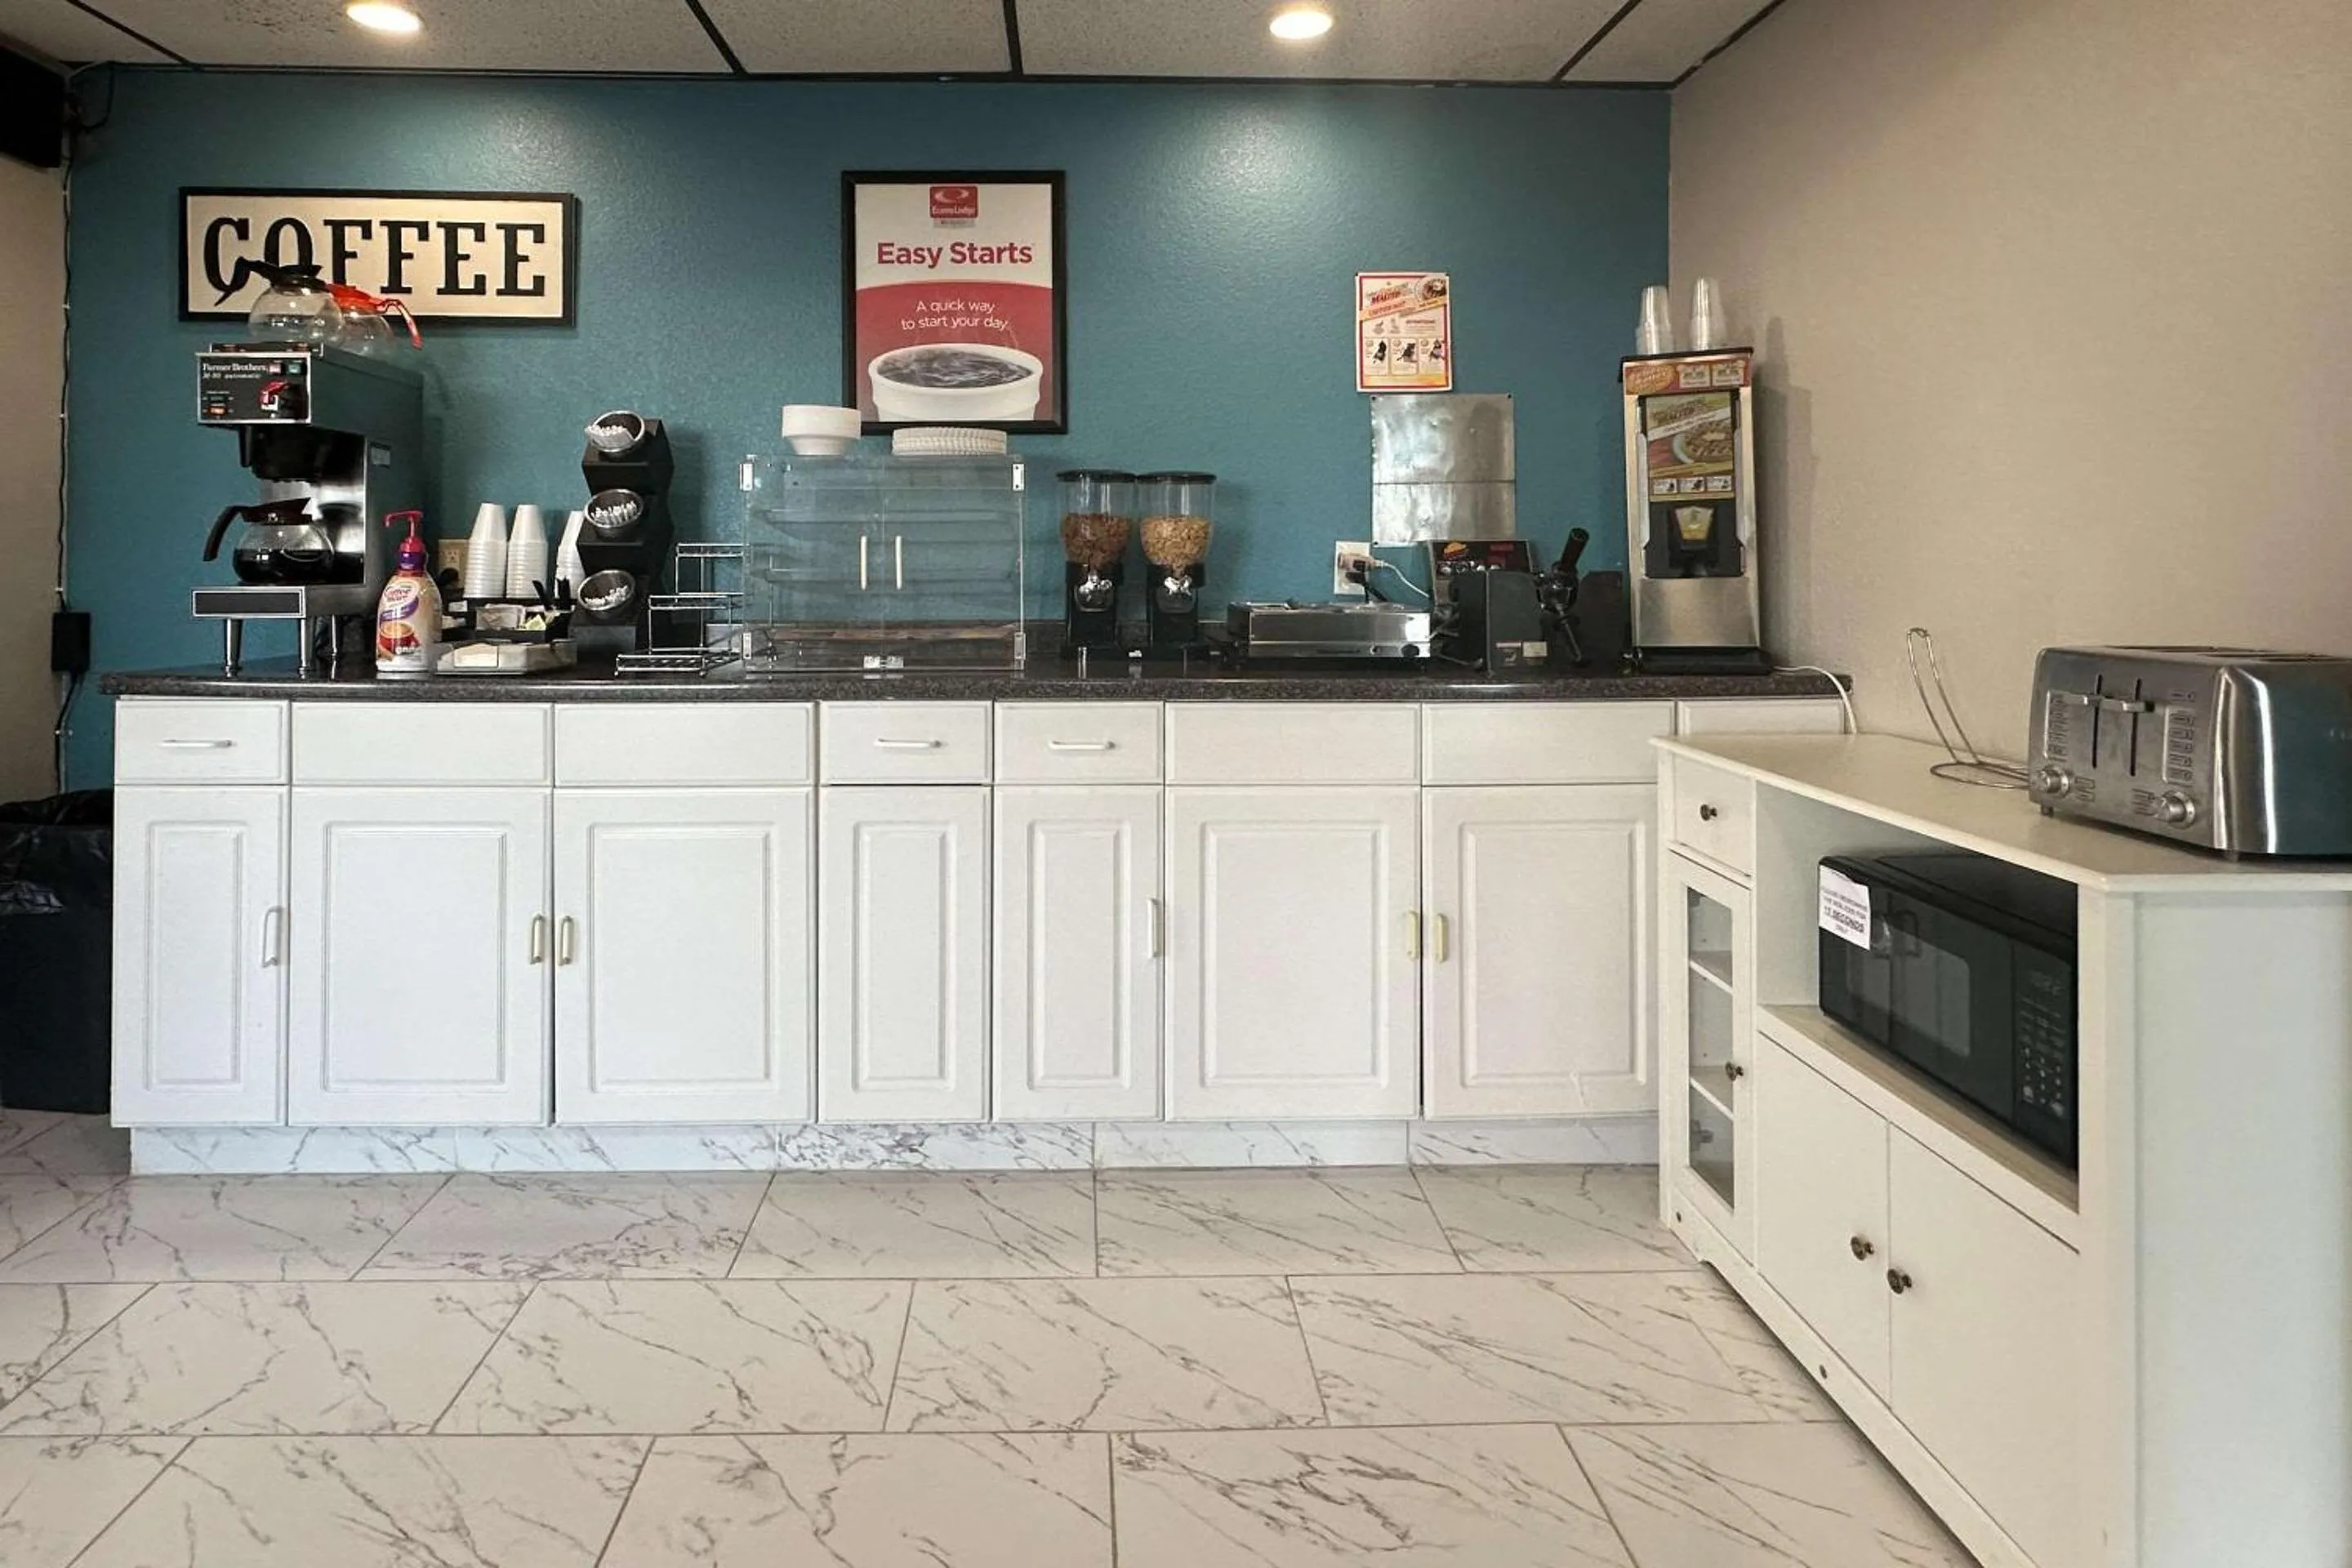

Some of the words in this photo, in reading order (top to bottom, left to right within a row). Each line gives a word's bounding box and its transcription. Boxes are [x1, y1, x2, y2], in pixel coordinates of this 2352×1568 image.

[204, 217, 545, 296] COFFEE
[878, 243, 942, 269] Easy
[950, 242, 1032, 264] Starts
[915, 301, 927, 312] A
[930, 298, 964, 314] quick
[969, 302, 995, 314] way
[901, 318, 915, 330] to
[918, 316, 947, 327] start
[951, 317, 980, 329] your
